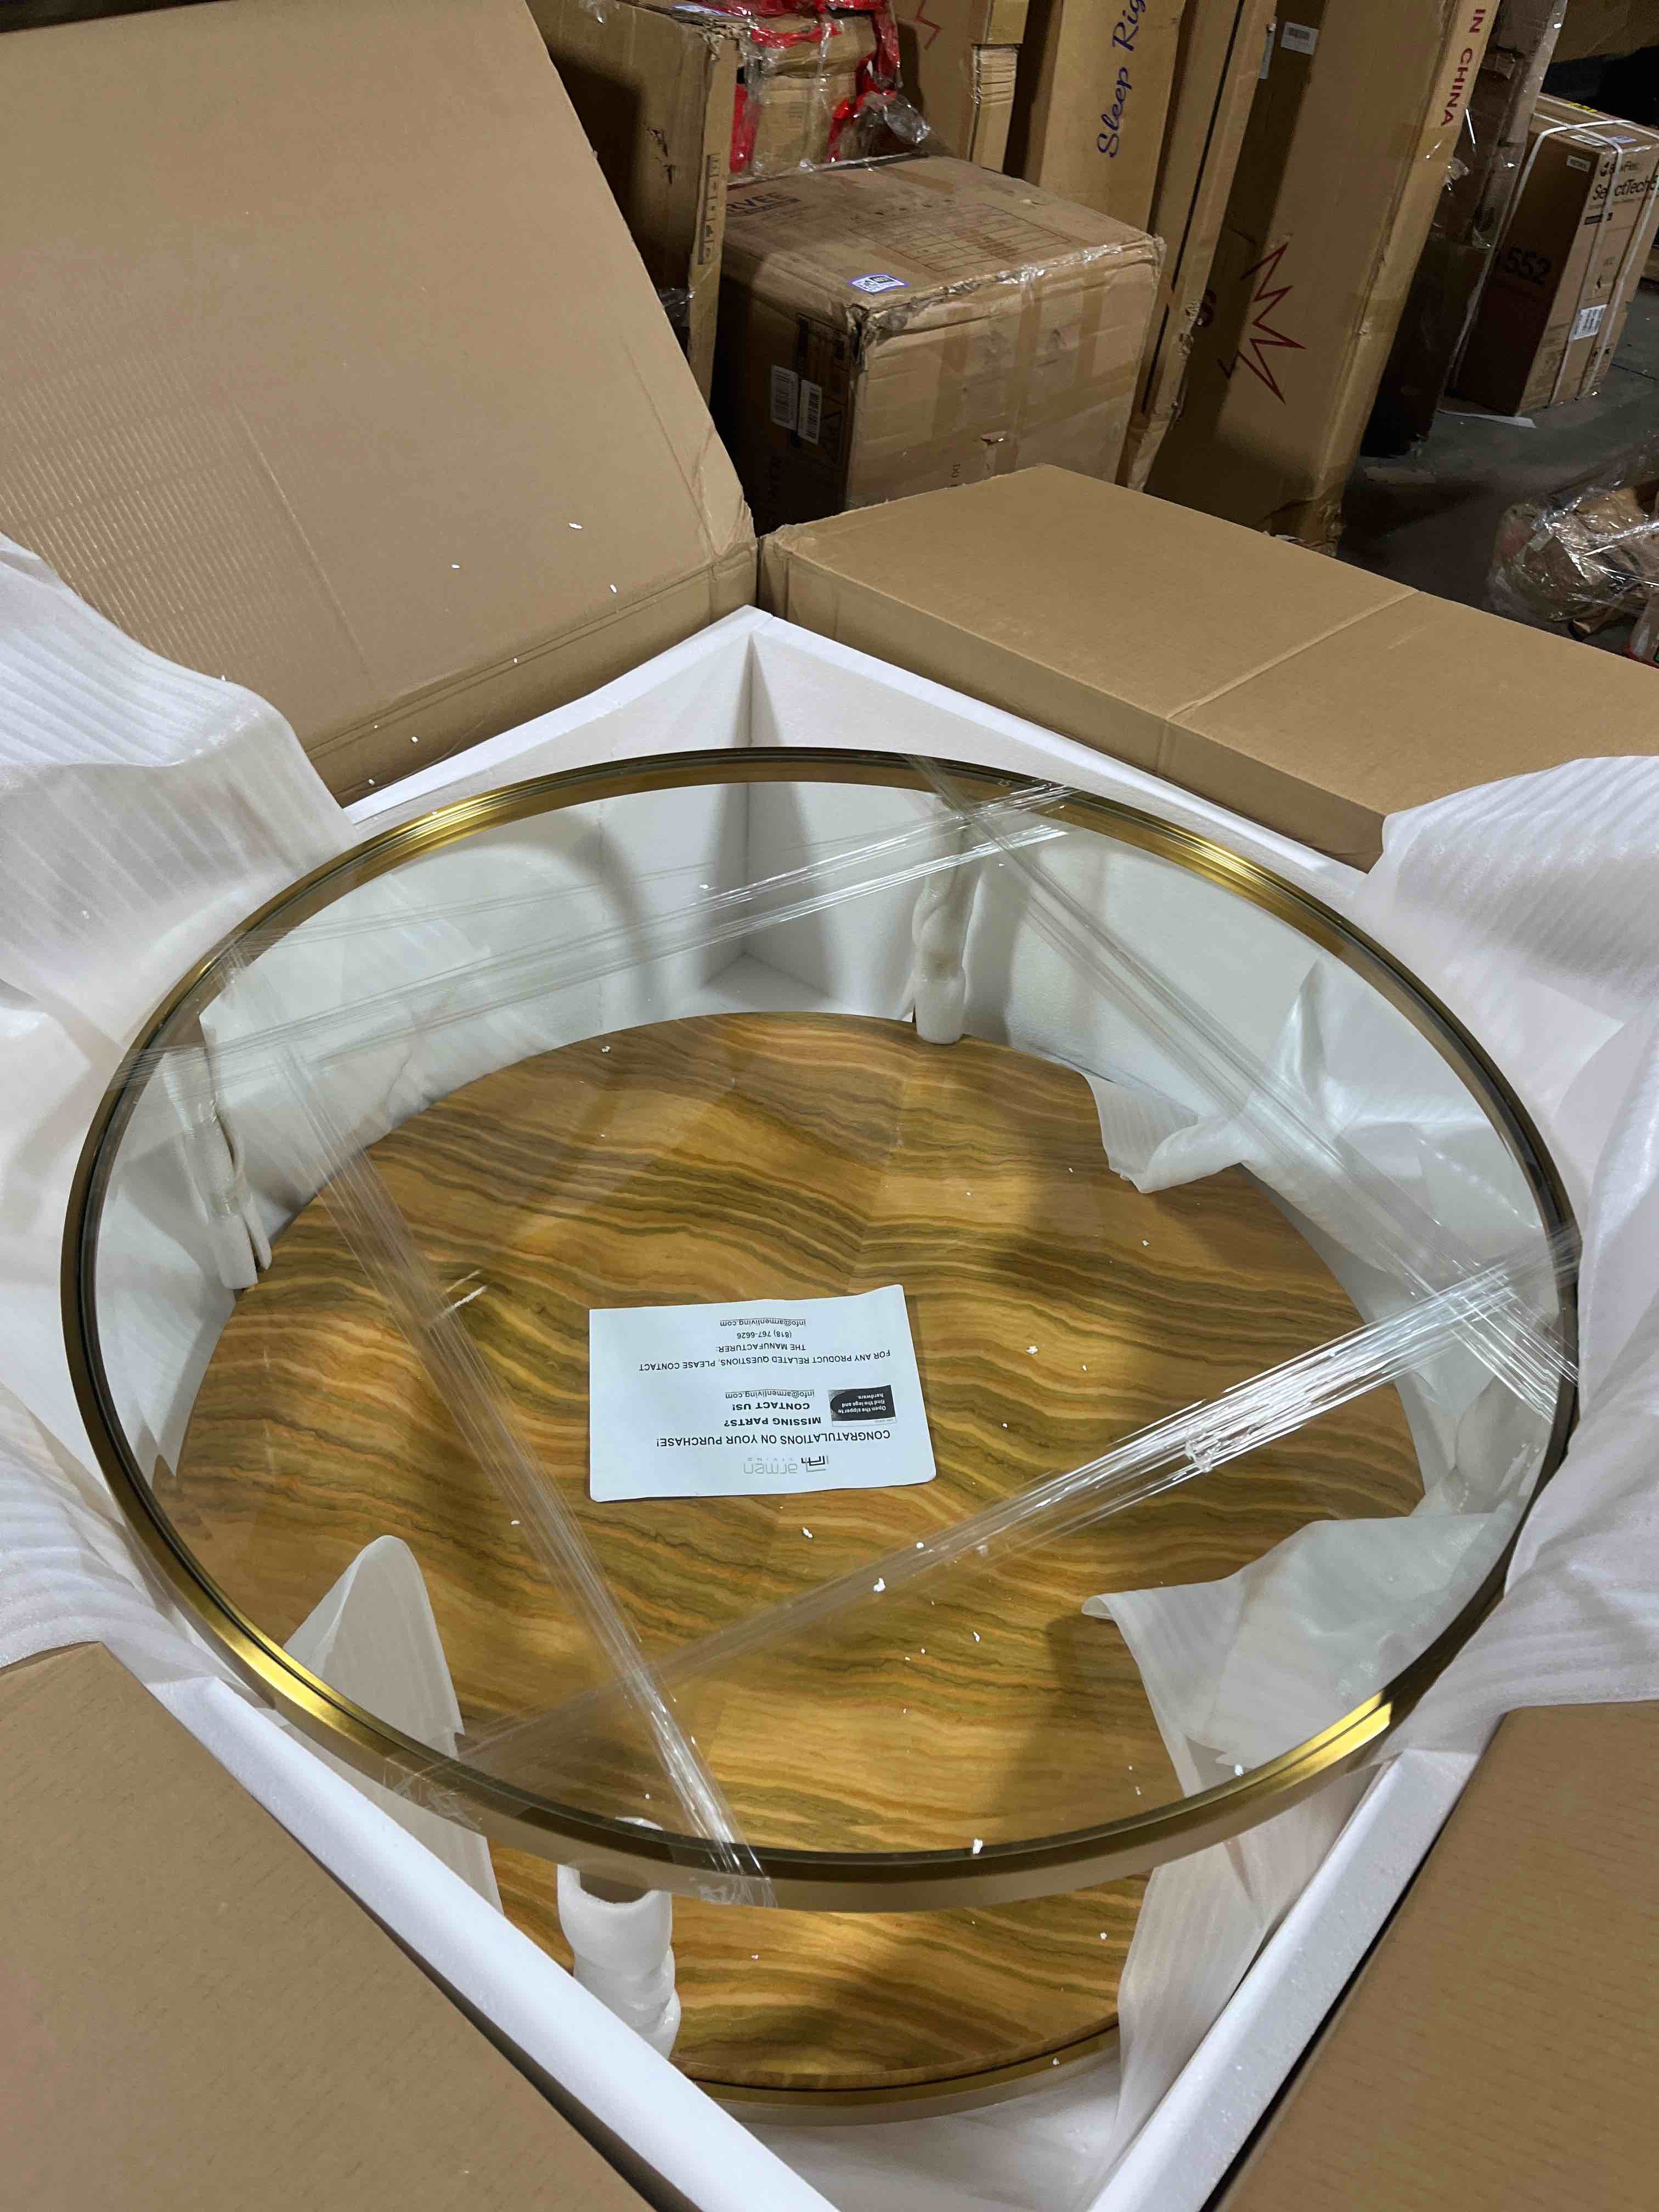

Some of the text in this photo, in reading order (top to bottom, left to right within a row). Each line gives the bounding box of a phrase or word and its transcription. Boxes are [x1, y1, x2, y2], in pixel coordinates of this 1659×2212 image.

[1441, 9, 1486, 126] IN CHINA
[1097, 66, 1132, 158] Sleep
[720, 1318, 806, 1328] info@armenliving.com
[737, 1330, 792, 1339] (818) 767-6626
[716, 1344, 787, 1352] MANUFACTURER:
[639, 1350, 890, 1371] FOR ANY PRODUCT RELATED QUESTIONS, PLEASE CONTACT
[725, 1389, 814, 1400] info@armenliving.com
[755, 1402, 810, 1410] CONTACT
[724, 1417, 821, 1426] MISSING PARTS?
[656, 1430, 890, 1447] CONGRATULATIONS ON YOUR PURCHASE!
[743, 1463, 798, 1474] armen
